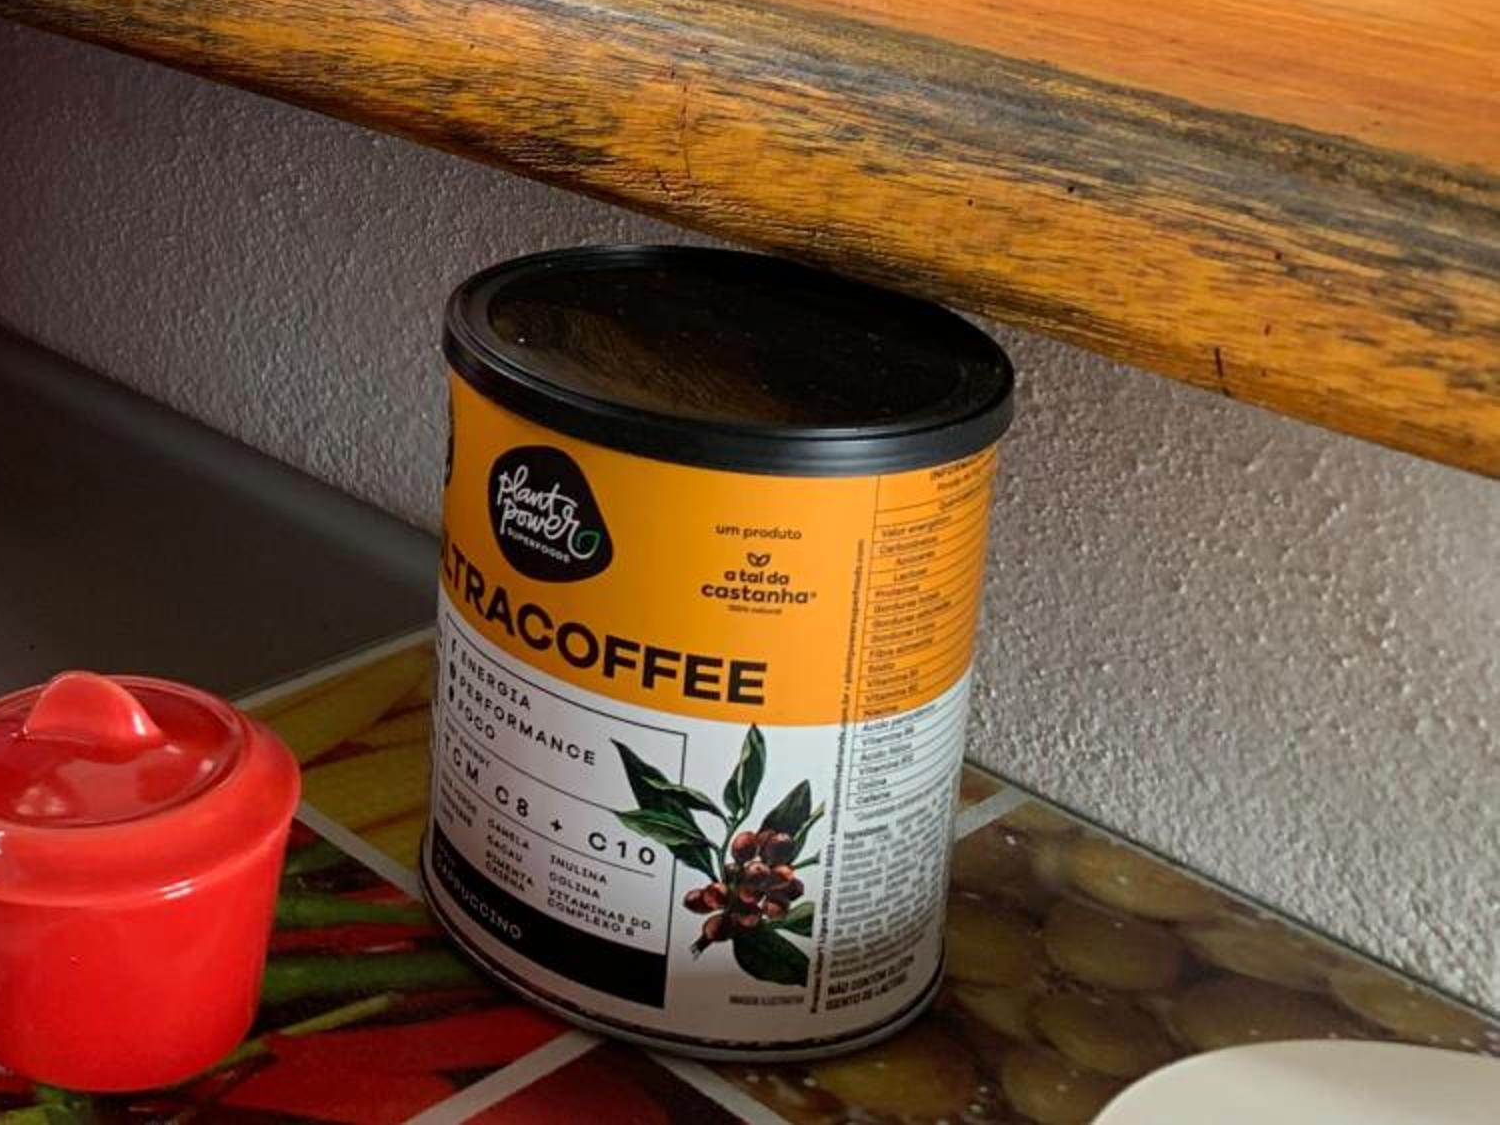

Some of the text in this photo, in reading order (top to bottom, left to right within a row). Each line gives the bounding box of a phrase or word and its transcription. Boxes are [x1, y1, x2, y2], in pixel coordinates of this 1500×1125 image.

[497, 464, 578, 510] plant
[715, 525, 802, 540] um produto
[724, 568, 789, 585] a tal da
[442, 530, 767, 705] LTRACOFFEE
[462, 651, 531, 711] ENERGIA
[459, 675, 596, 766] PERFORMANCE
[551, 819, 563, 833] +
[549, 872, 600, 899] COLINA
[550, 855, 608, 886] INULINA
[548, 899, 621, 932] COMPLEXO
[549, 890, 652, 931] VITAMINAS DO
